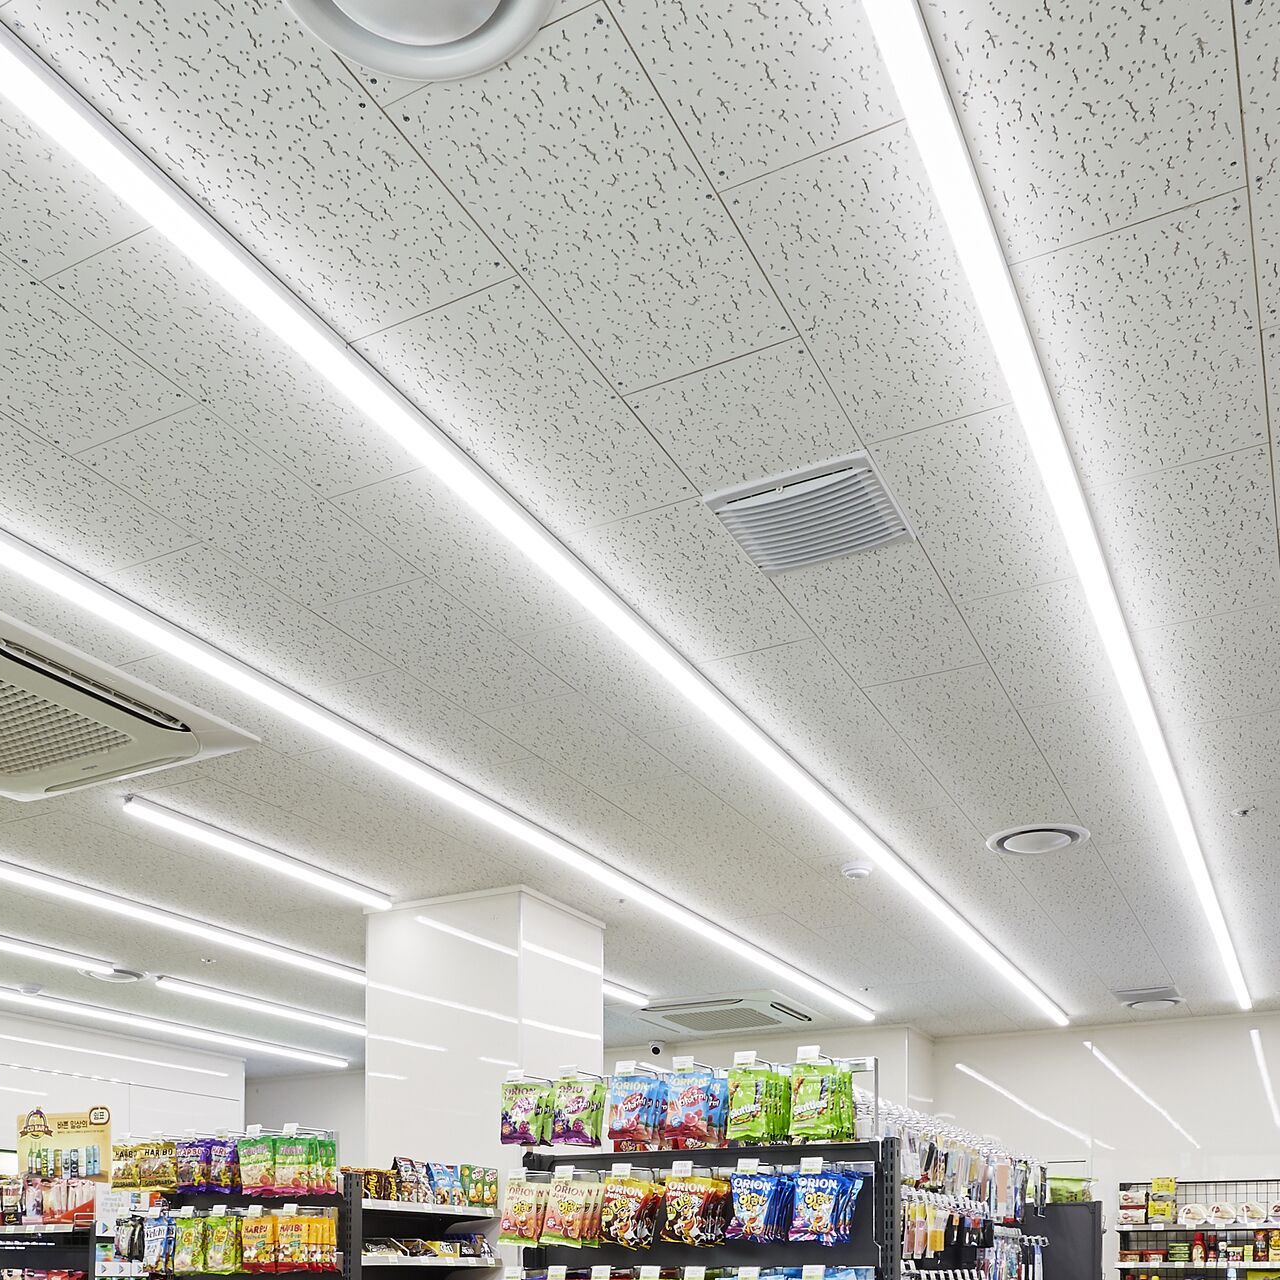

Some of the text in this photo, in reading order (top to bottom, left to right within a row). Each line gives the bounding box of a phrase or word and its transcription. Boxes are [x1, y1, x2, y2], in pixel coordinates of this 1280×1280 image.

[559, 1085, 583, 1095] ORIO
[668, 1181, 706, 1193] ORION
[733, 1178, 772, 1191] ORION
[797, 1177, 837, 1189] ORION
[607, 1183, 644, 1198] ORION
